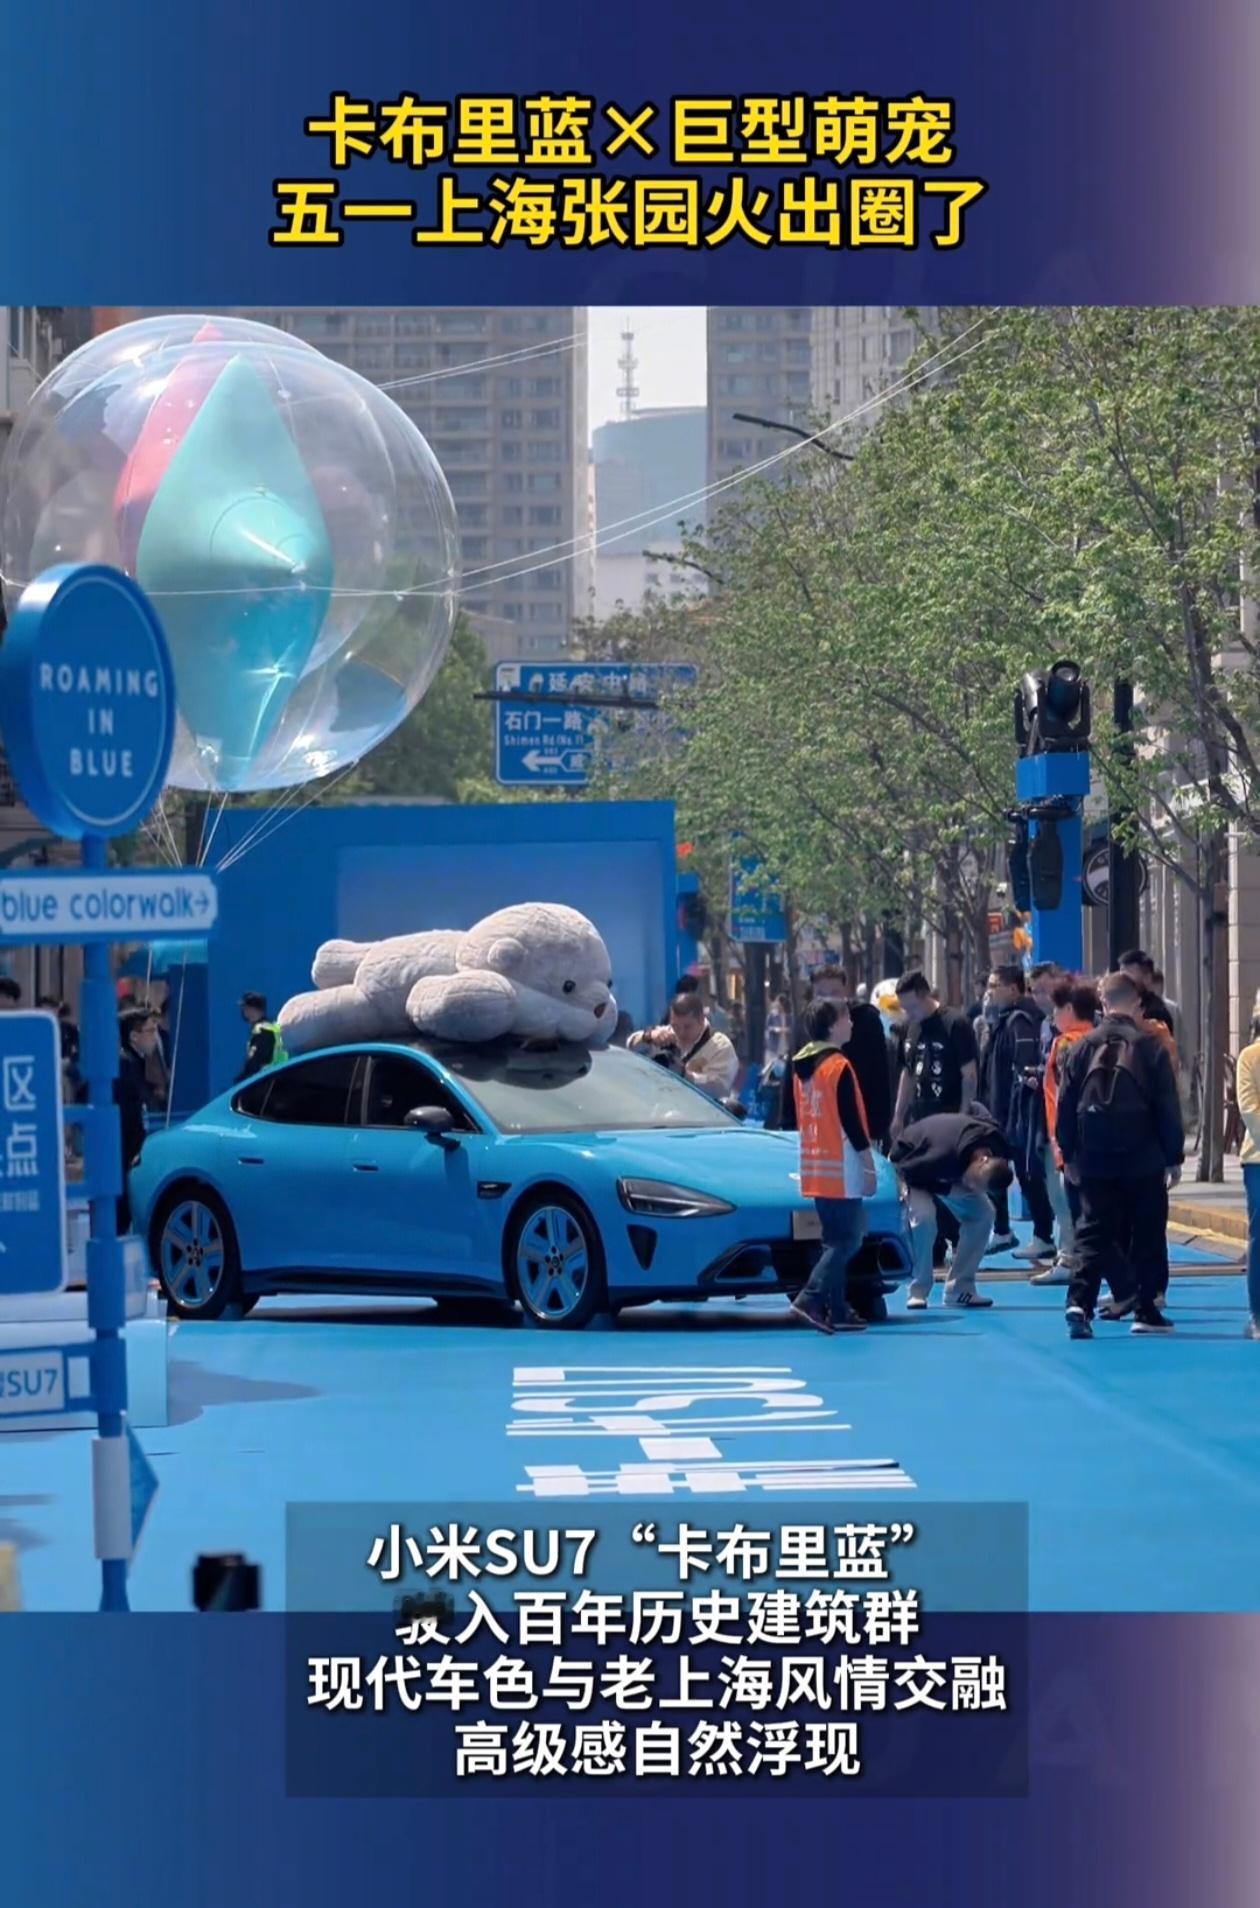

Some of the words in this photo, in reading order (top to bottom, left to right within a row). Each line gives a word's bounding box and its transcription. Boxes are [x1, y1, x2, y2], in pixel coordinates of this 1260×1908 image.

[40, 662, 158, 698] ROAMING
[88, 708, 113, 735] IN
[504, 710, 582, 731] 石门一路
[70, 747, 133, 777] BLUE
[1, 889, 58, 922] blue
[70, 887, 193, 921] colorwalk
[0, 1121, 38, 1178] 点
[0, 1368, 58, 1397] SU7
